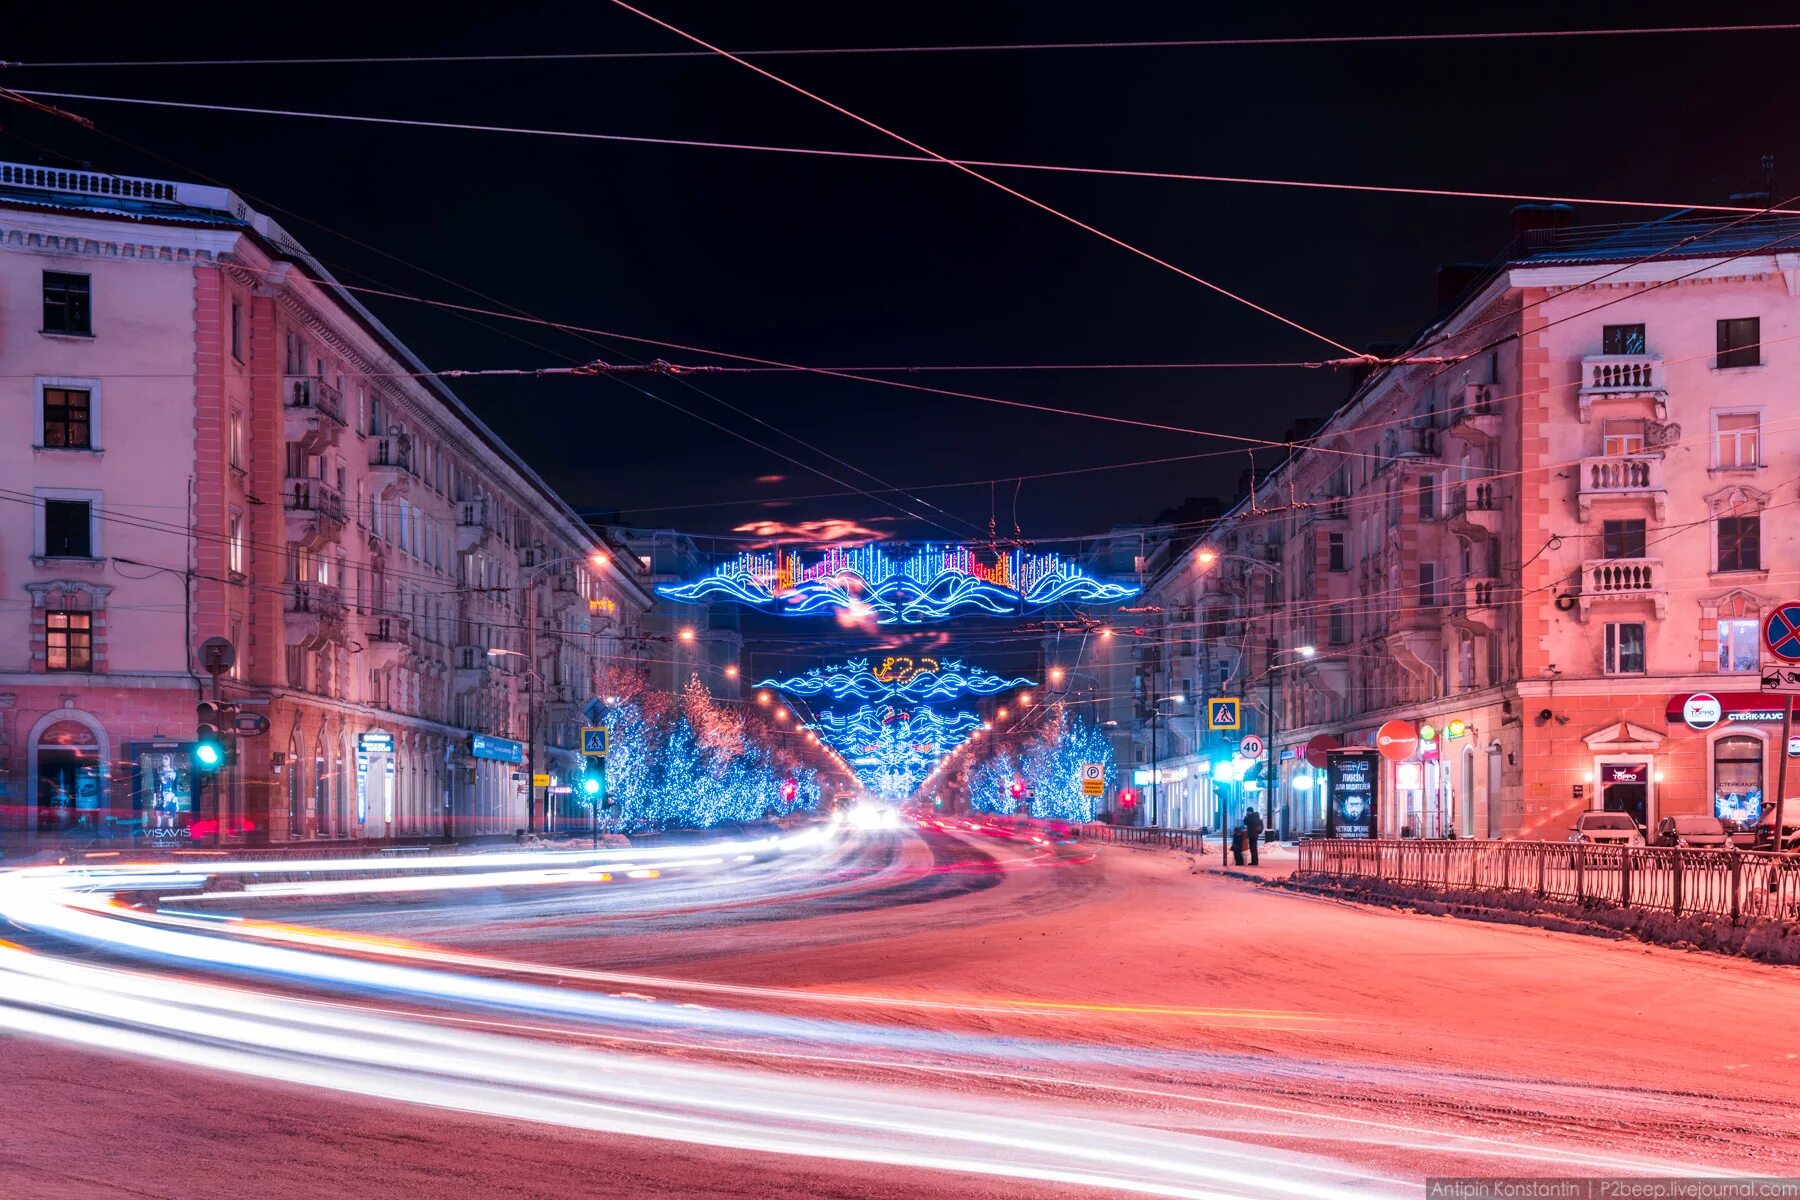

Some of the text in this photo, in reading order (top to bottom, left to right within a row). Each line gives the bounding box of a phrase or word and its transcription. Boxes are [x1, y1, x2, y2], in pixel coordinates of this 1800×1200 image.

[1243, 742, 1258, 752] 40
[1342, 773, 1365, 782] ЛИНЗЫ
[1335, 782, 1371, 791] ДЛЯ ВОДИТЕЛЕЙ
[142, 828, 192, 838] VISAVIS
